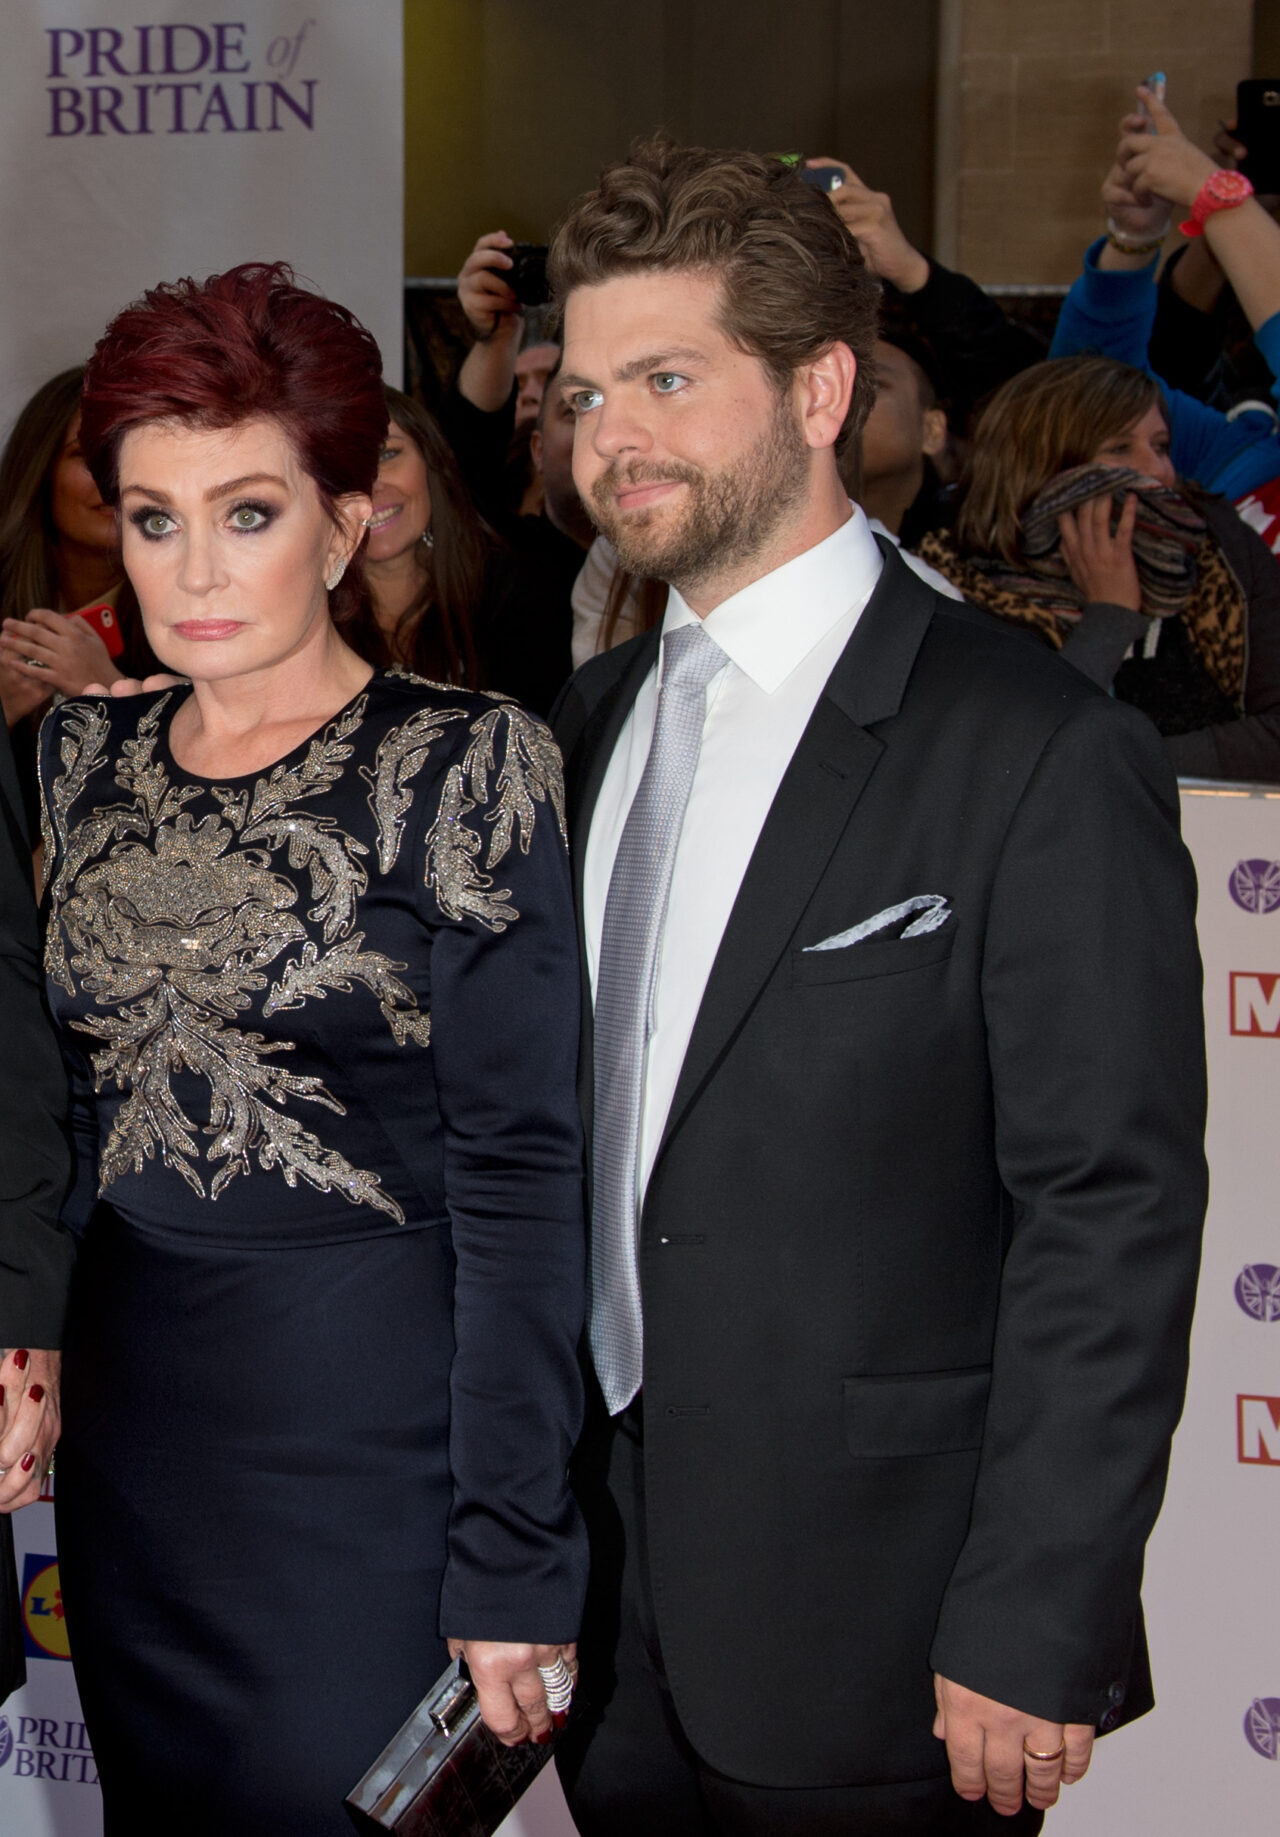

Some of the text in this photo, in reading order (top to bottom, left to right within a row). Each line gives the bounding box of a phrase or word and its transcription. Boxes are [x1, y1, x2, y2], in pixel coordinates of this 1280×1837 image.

[46, 18, 317, 80] PRIDE of
[46, 79, 318, 138] BRITAIN
[13, 1748, 99, 1785] BRIT
